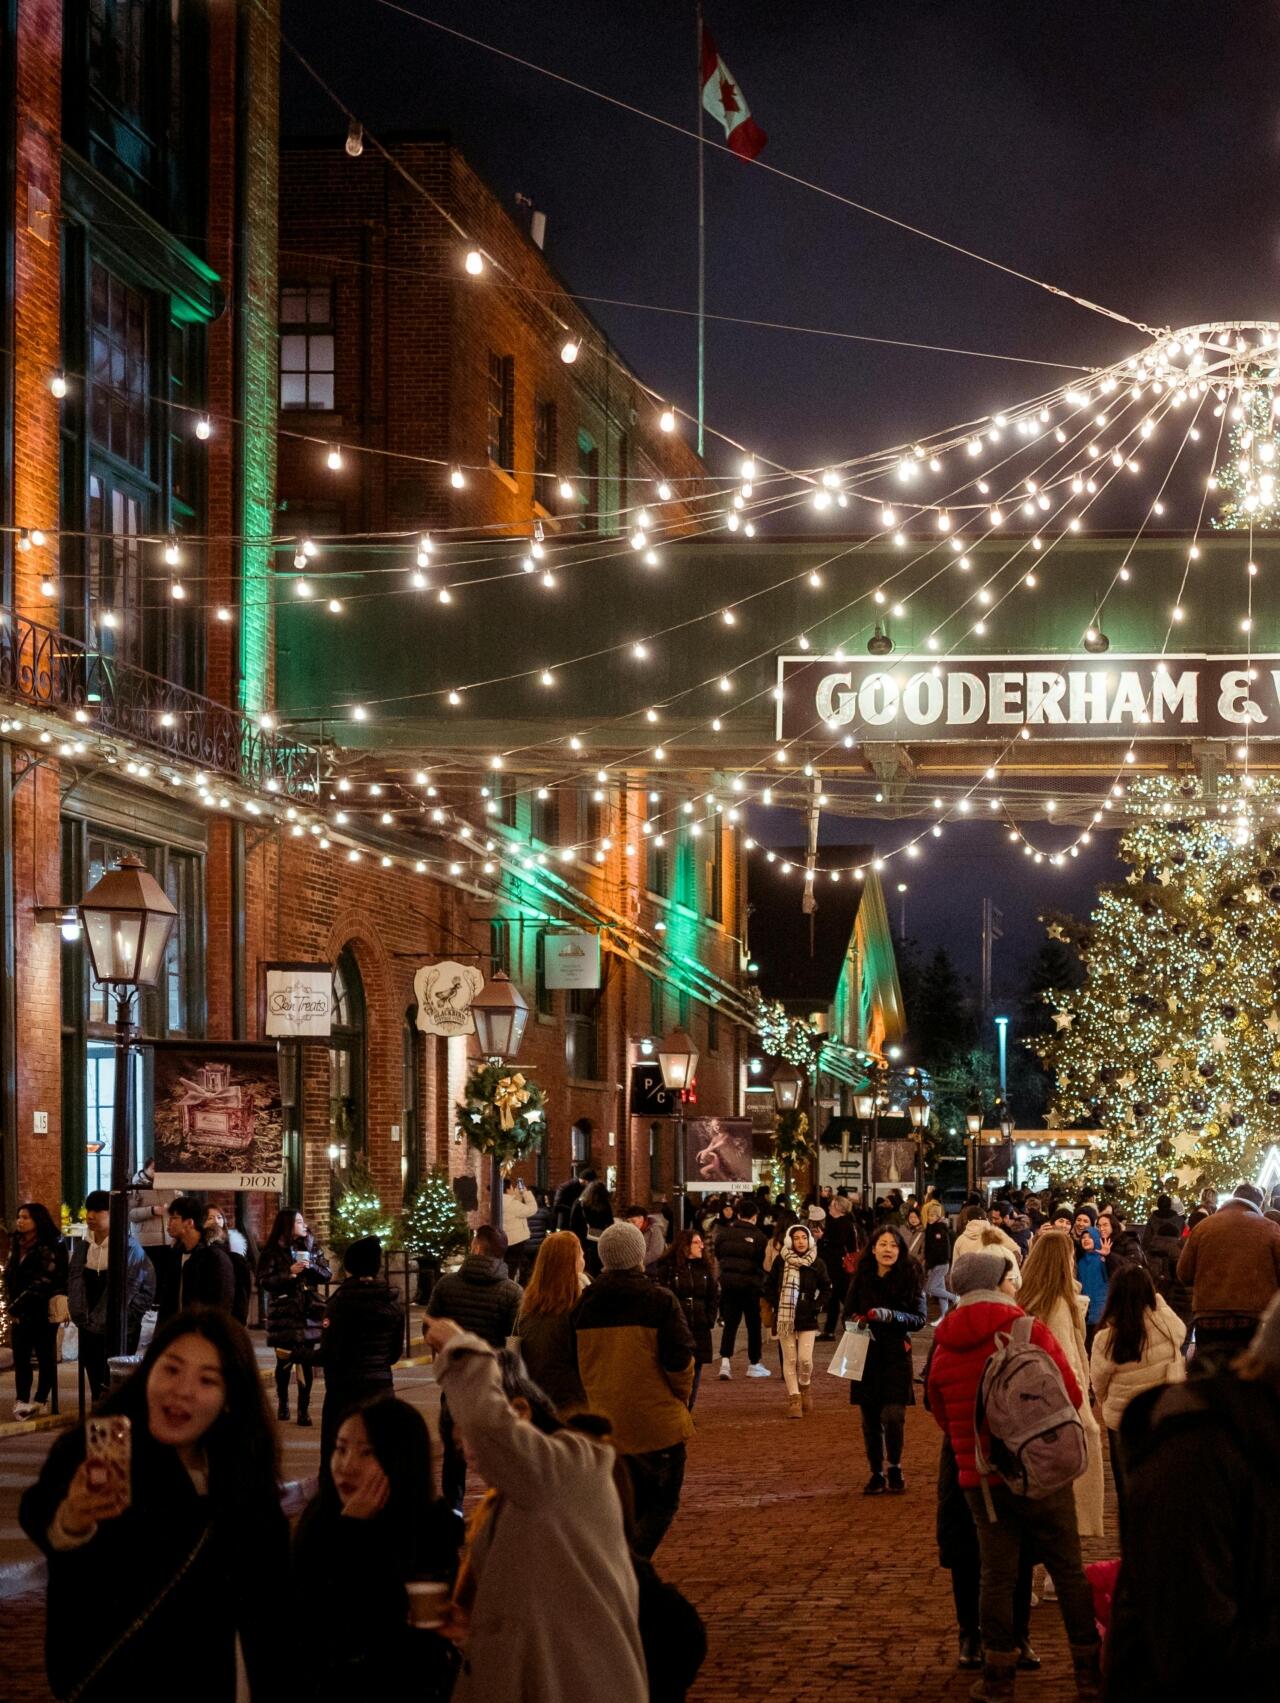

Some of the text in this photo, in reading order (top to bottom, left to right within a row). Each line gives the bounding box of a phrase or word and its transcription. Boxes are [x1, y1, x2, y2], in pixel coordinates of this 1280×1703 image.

[816, 671, 1200, 726] GOODERHAM
[1217, 670, 1268, 724] &
[294, 995, 326, 1012] Treats
[240, 1176, 276, 1187] DIOR
